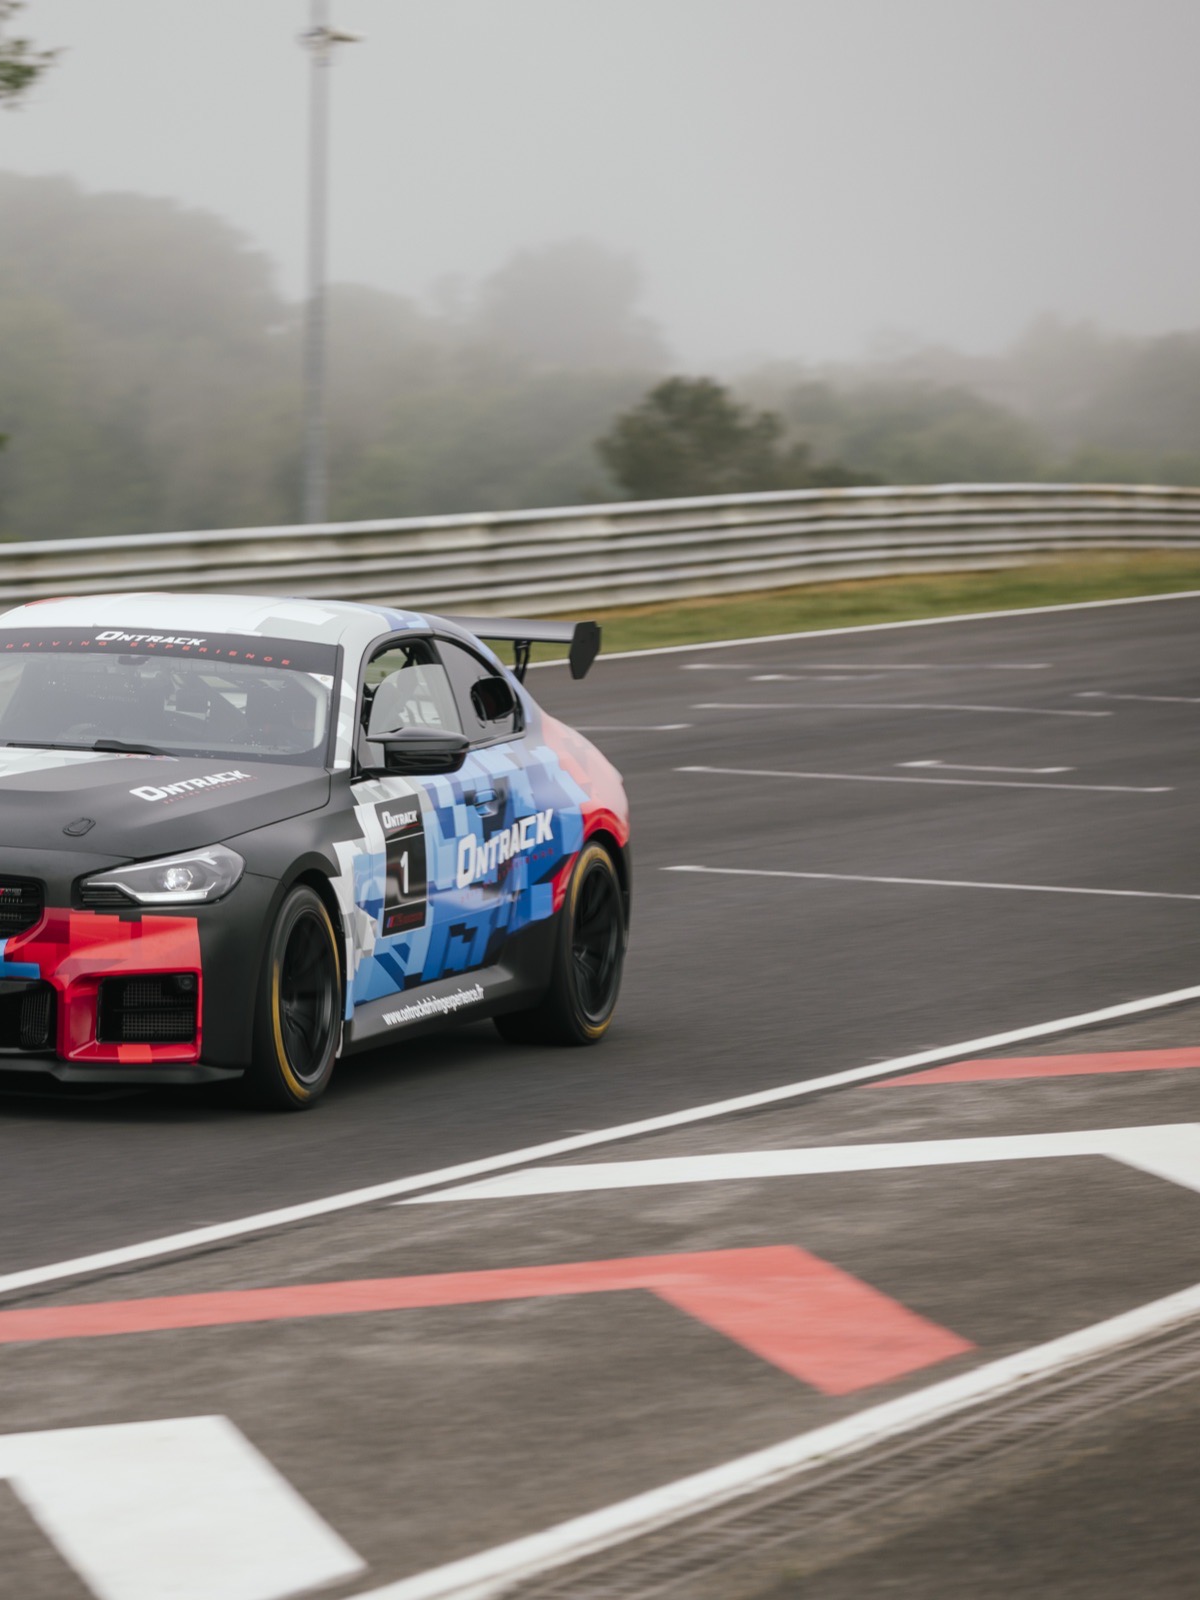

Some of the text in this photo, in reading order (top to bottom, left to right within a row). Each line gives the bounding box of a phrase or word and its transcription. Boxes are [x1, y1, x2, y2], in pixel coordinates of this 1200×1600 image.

[5, 640, 290, 666] DRIVING EXPERIENCE
[400, 851, 409, 894] 1
